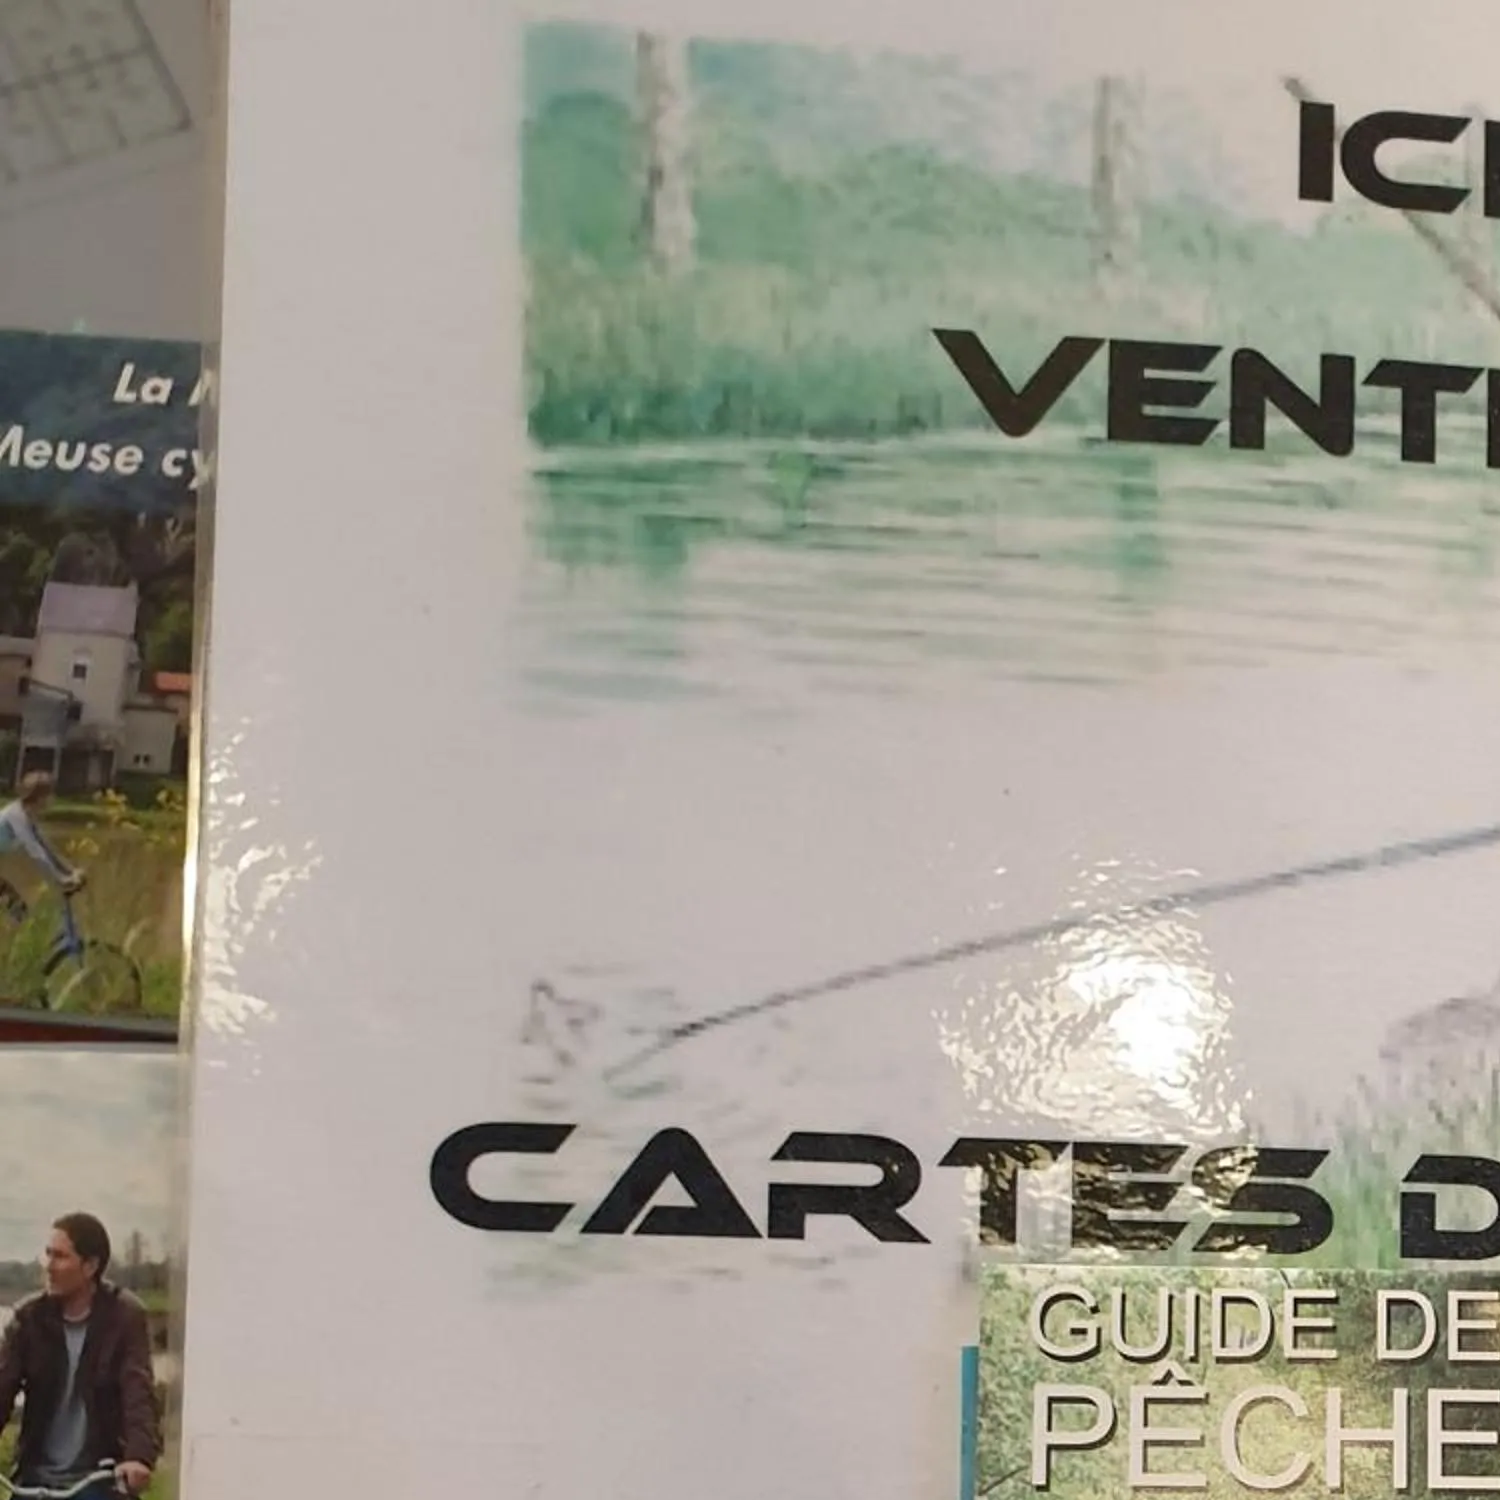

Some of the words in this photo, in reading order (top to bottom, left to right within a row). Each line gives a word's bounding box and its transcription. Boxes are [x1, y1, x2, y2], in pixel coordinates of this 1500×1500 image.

[113, 361, 174, 405] La
[430, 1121, 1333, 1255] CARTES
[1030, 1284, 1339, 1361] GUIDE
